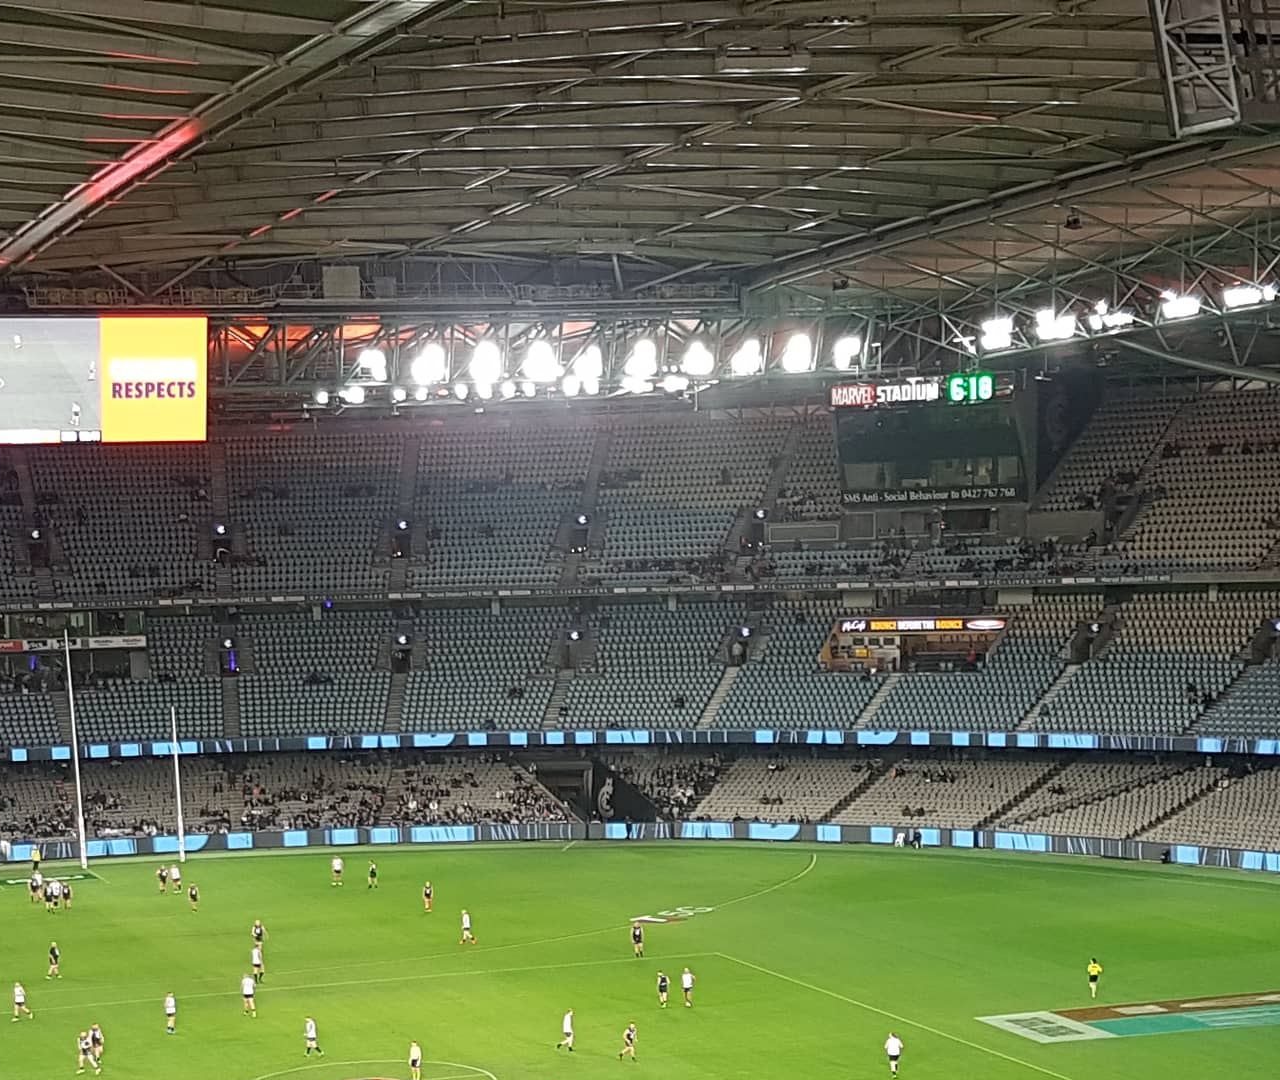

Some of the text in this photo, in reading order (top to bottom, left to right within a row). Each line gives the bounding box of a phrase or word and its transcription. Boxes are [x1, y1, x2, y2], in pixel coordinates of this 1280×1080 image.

[111, 381, 196, 400] RESPECTS
[831, 378, 939, 406] MARVEL STADIUM
[949, 375, 993, 402] 6:18
[884, 490, 907, 501] Social
[909, 488, 949, 500] Behaviour
